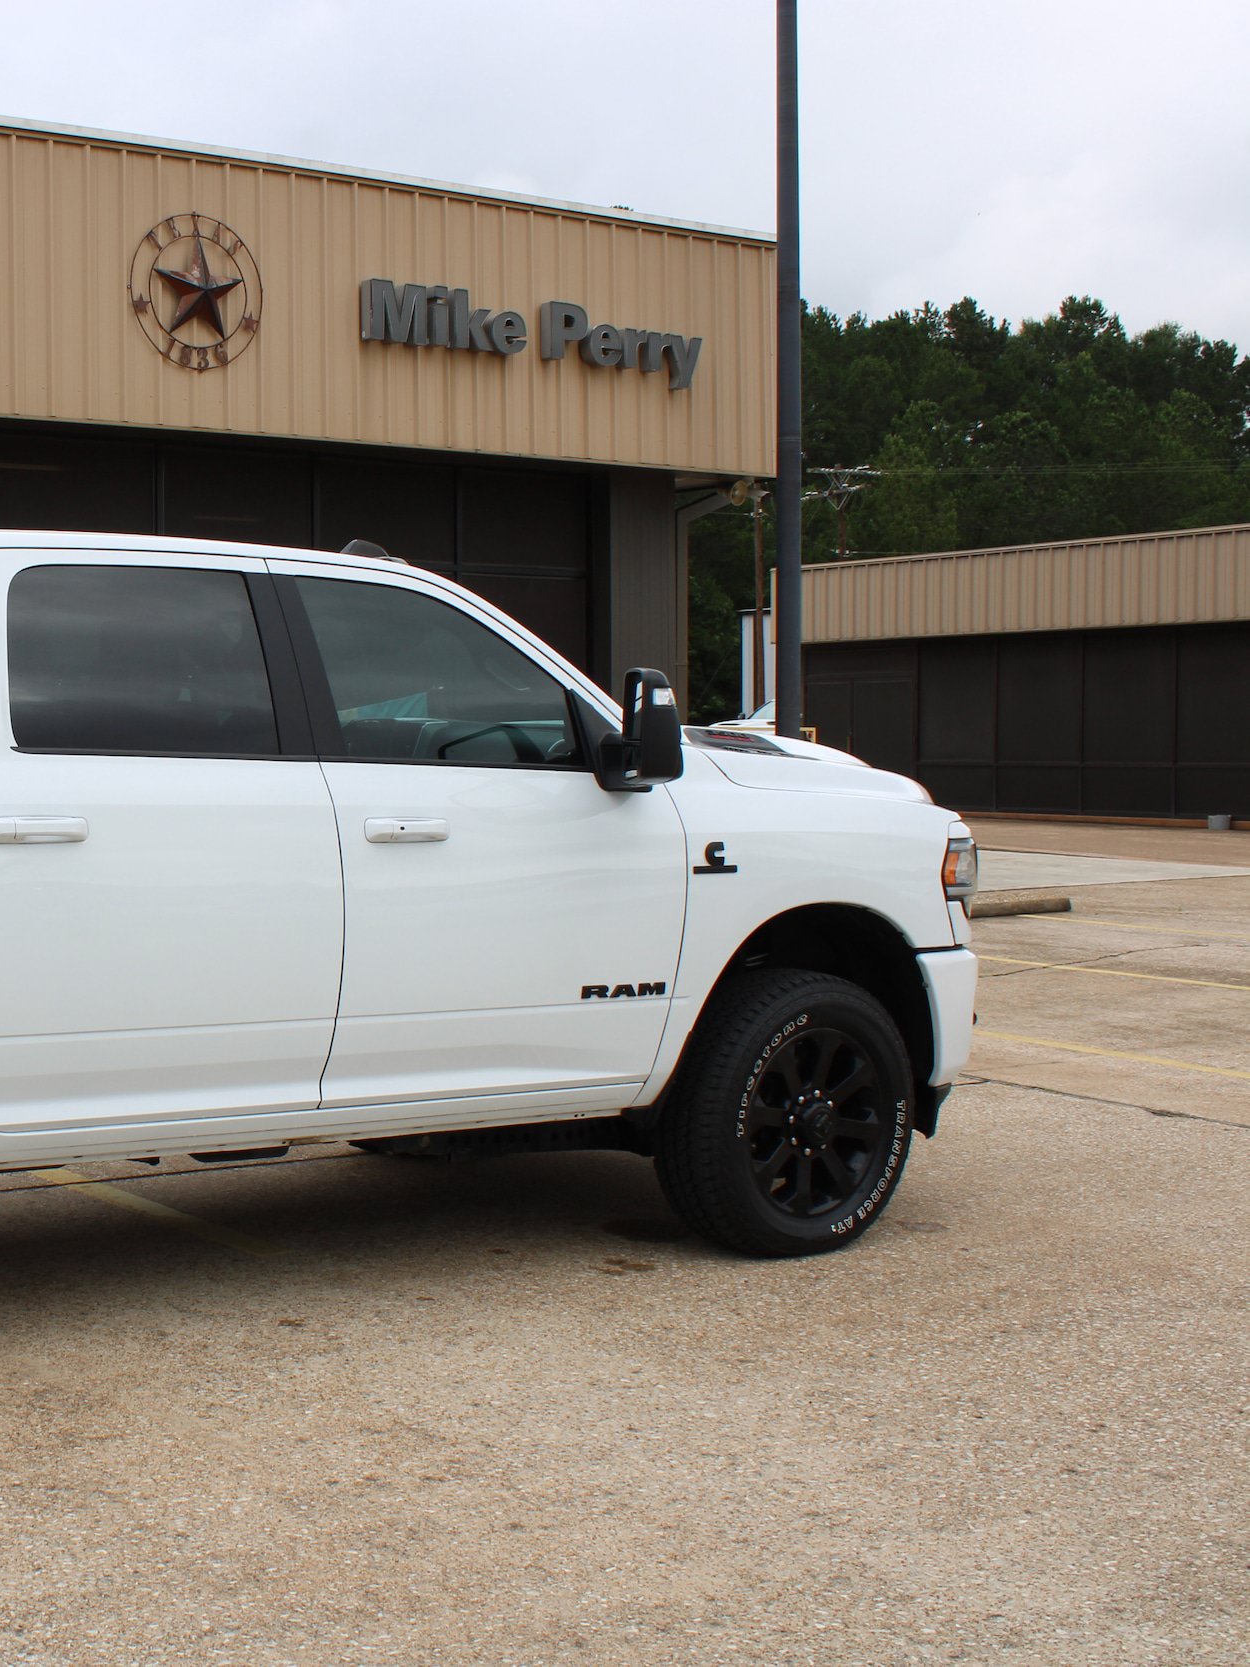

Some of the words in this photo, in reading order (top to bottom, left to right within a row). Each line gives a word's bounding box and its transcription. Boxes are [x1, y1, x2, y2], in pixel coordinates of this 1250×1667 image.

[146, 212, 243, 257] TEXAS
[360, 278, 528, 355] Mike
[540, 300, 703, 390] Perry
[581, 981, 666, 999] RAM
[857, 1099, 906, 1219] TRANSFORCE
